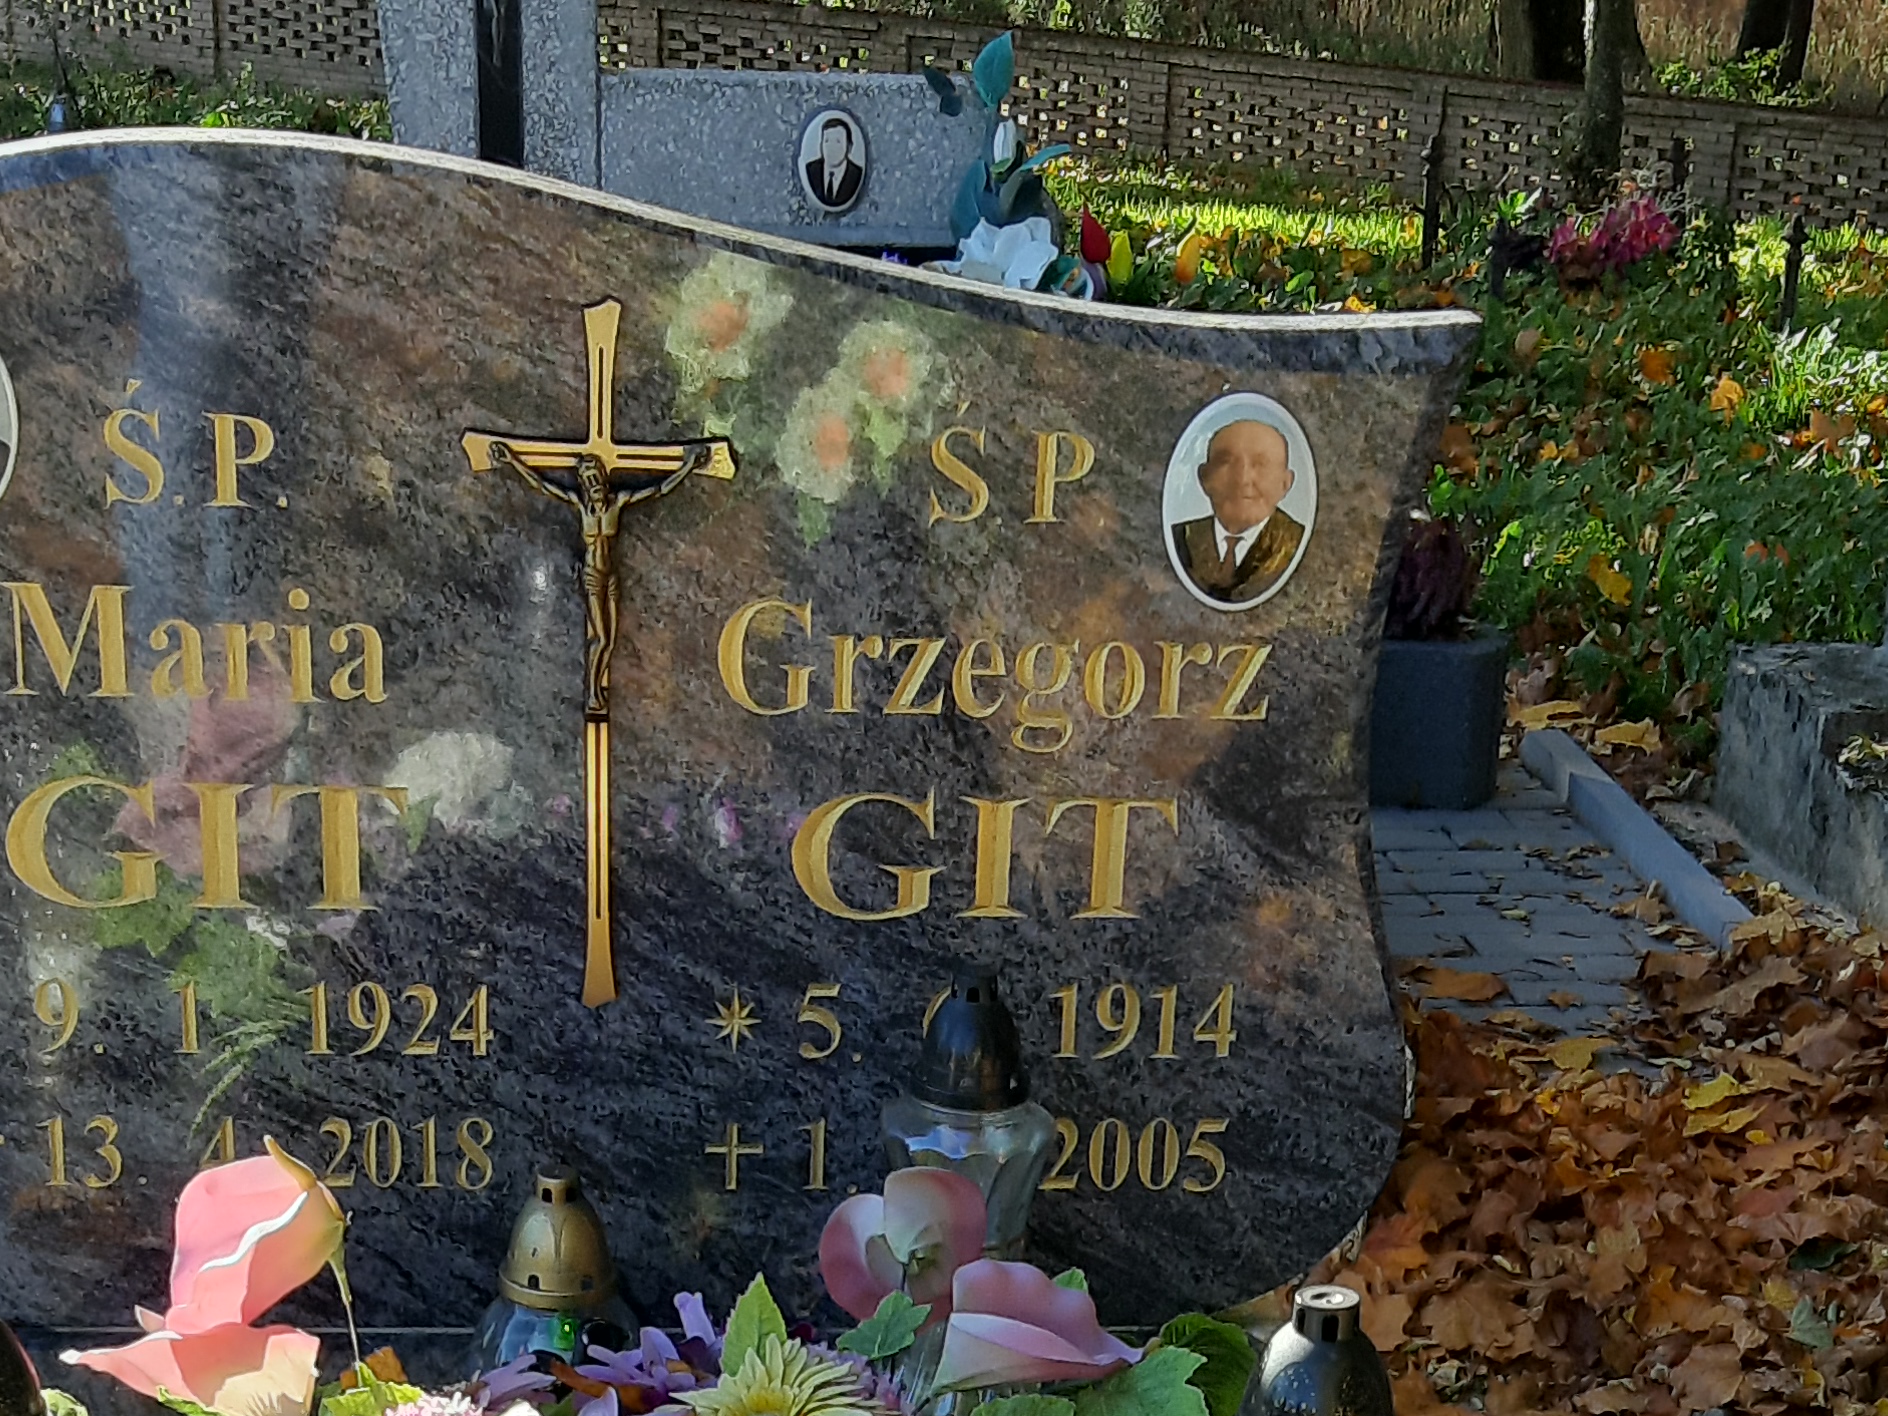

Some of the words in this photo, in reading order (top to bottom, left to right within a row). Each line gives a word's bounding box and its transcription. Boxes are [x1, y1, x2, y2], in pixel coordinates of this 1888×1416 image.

[717, 598, 1273, 753] Grzegorz
[4, 774, 410, 911] GIT
[790, 784, 1181, 921] GIT
[296, 979, 495, 1057] 1924
[1047, 981, 1238, 1060] 1914
[316, 1115, 494, 1191] 2018
[1038, 1116, 1230, 1194] 2005
